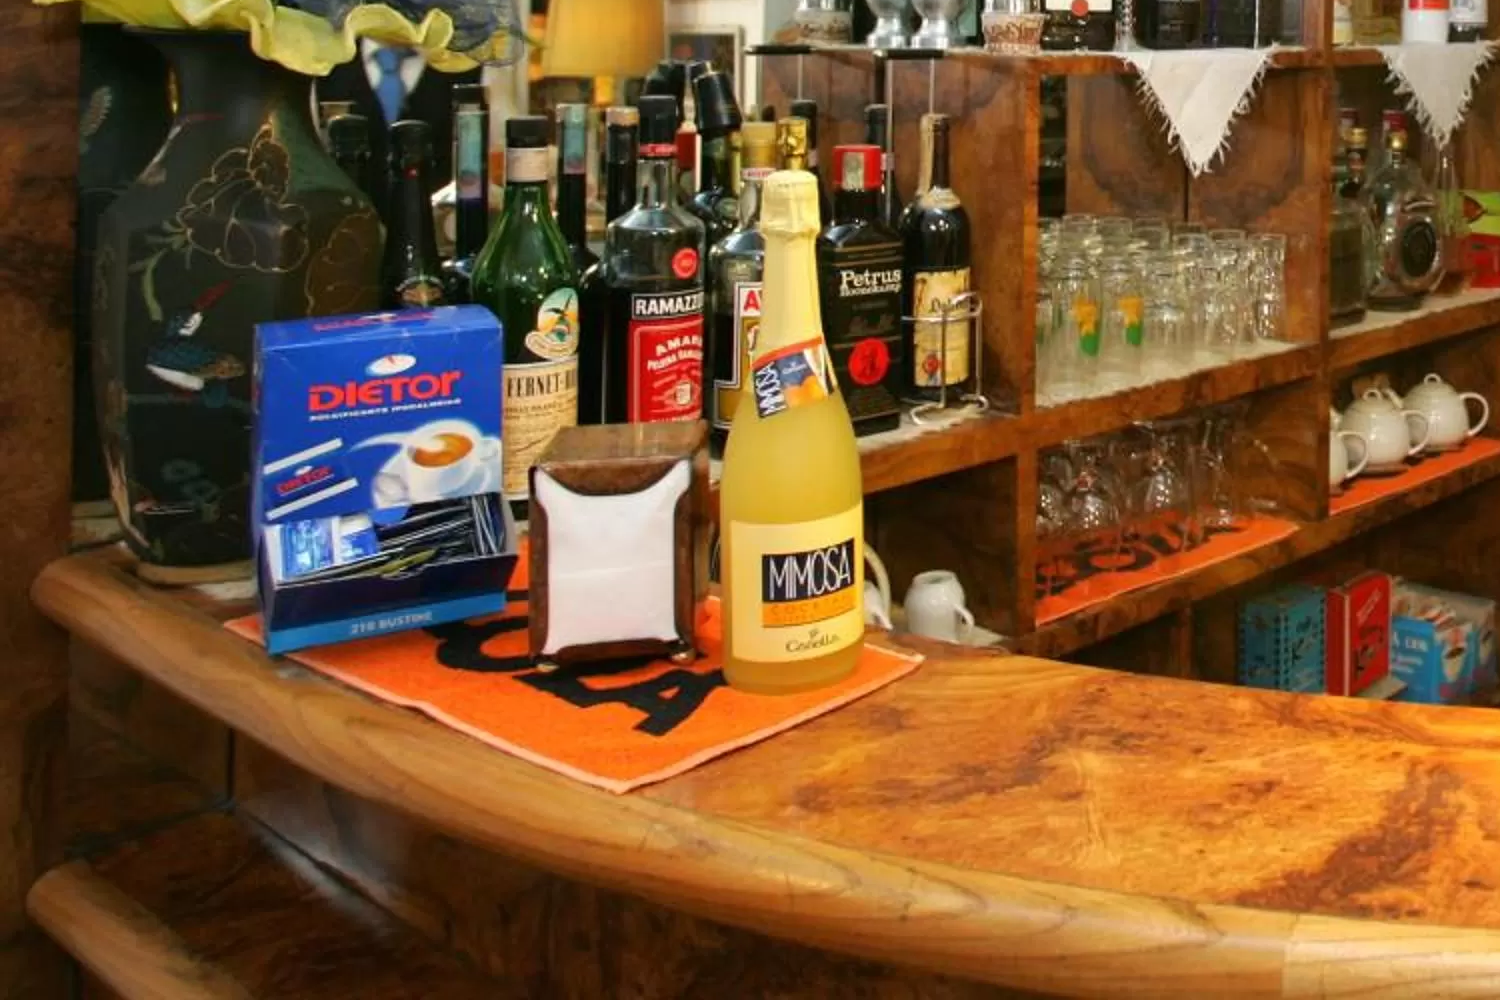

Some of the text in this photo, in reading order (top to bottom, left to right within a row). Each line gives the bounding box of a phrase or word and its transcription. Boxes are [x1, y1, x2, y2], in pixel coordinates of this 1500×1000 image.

[840, 268, 902, 288] Petrus
[308, 370, 463, 412] DIETOR
[769, 545, 851, 601] MIMOSA
